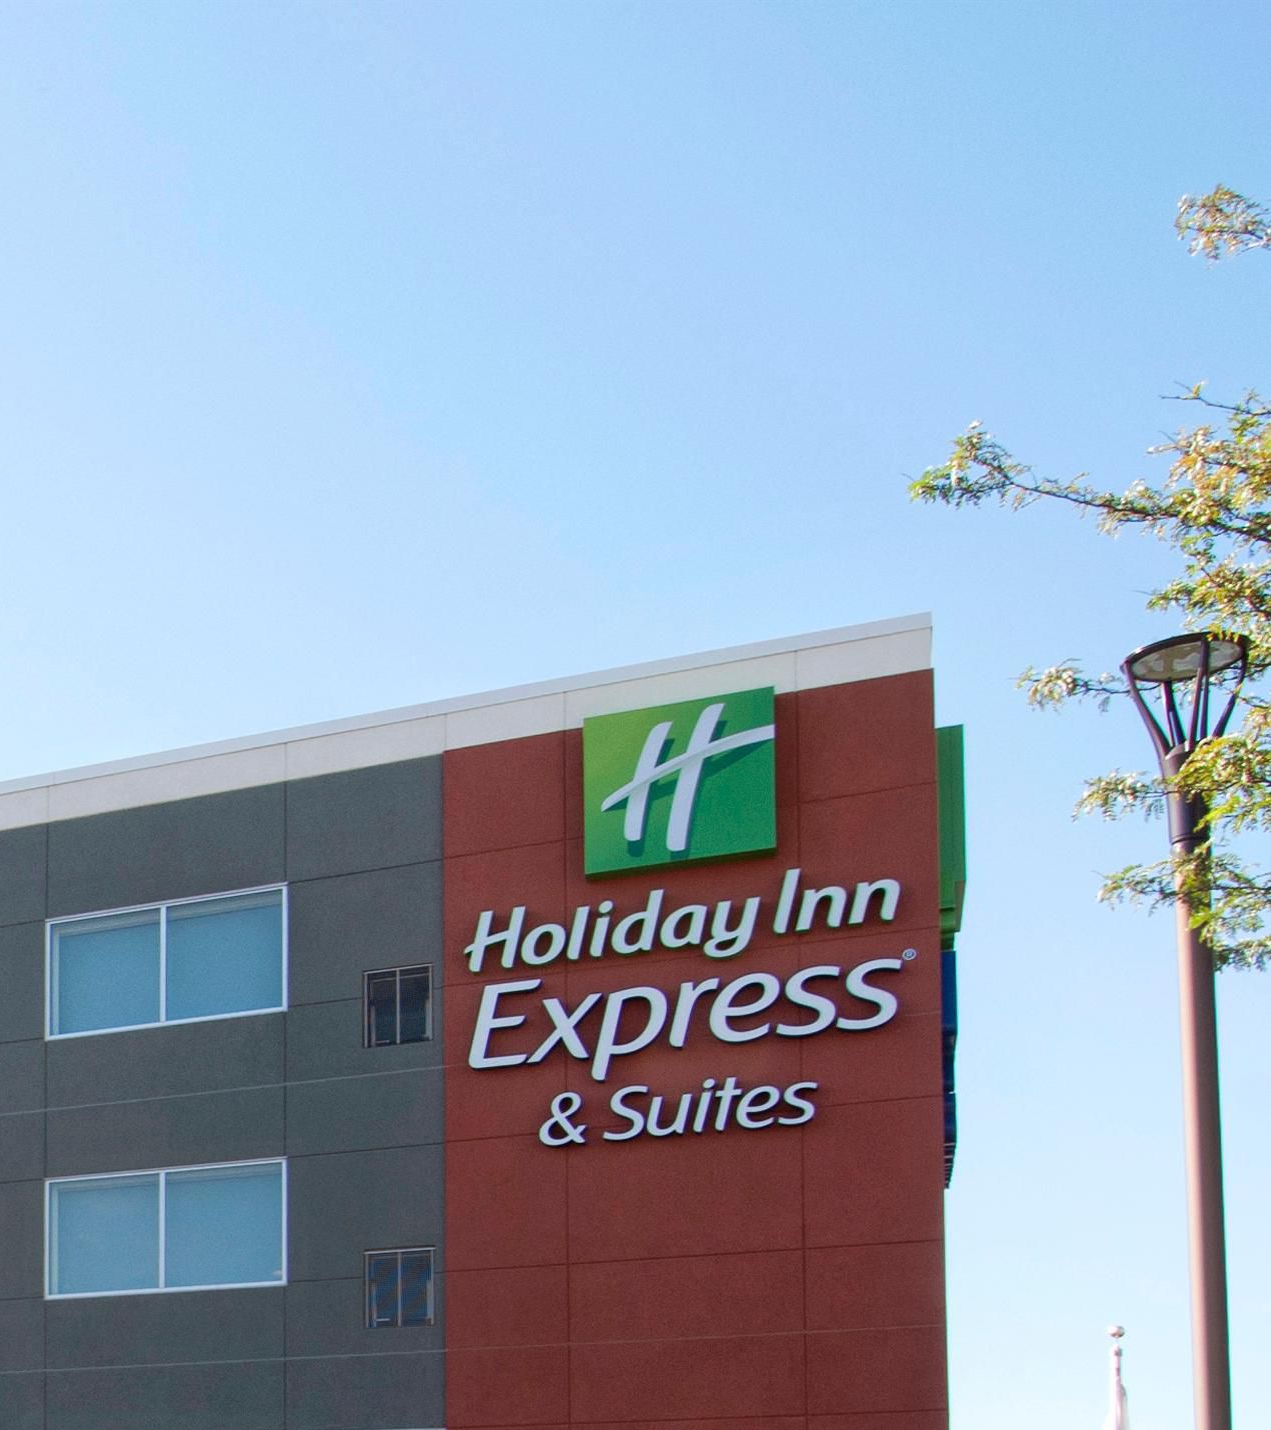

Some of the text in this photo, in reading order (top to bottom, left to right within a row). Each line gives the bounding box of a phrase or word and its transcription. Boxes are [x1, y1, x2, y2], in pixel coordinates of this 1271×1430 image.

[463, 868, 900, 973] Holiday Inn
[468, 958, 902, 1081] Express
[539, 1076, 818, 1146] & Suites
